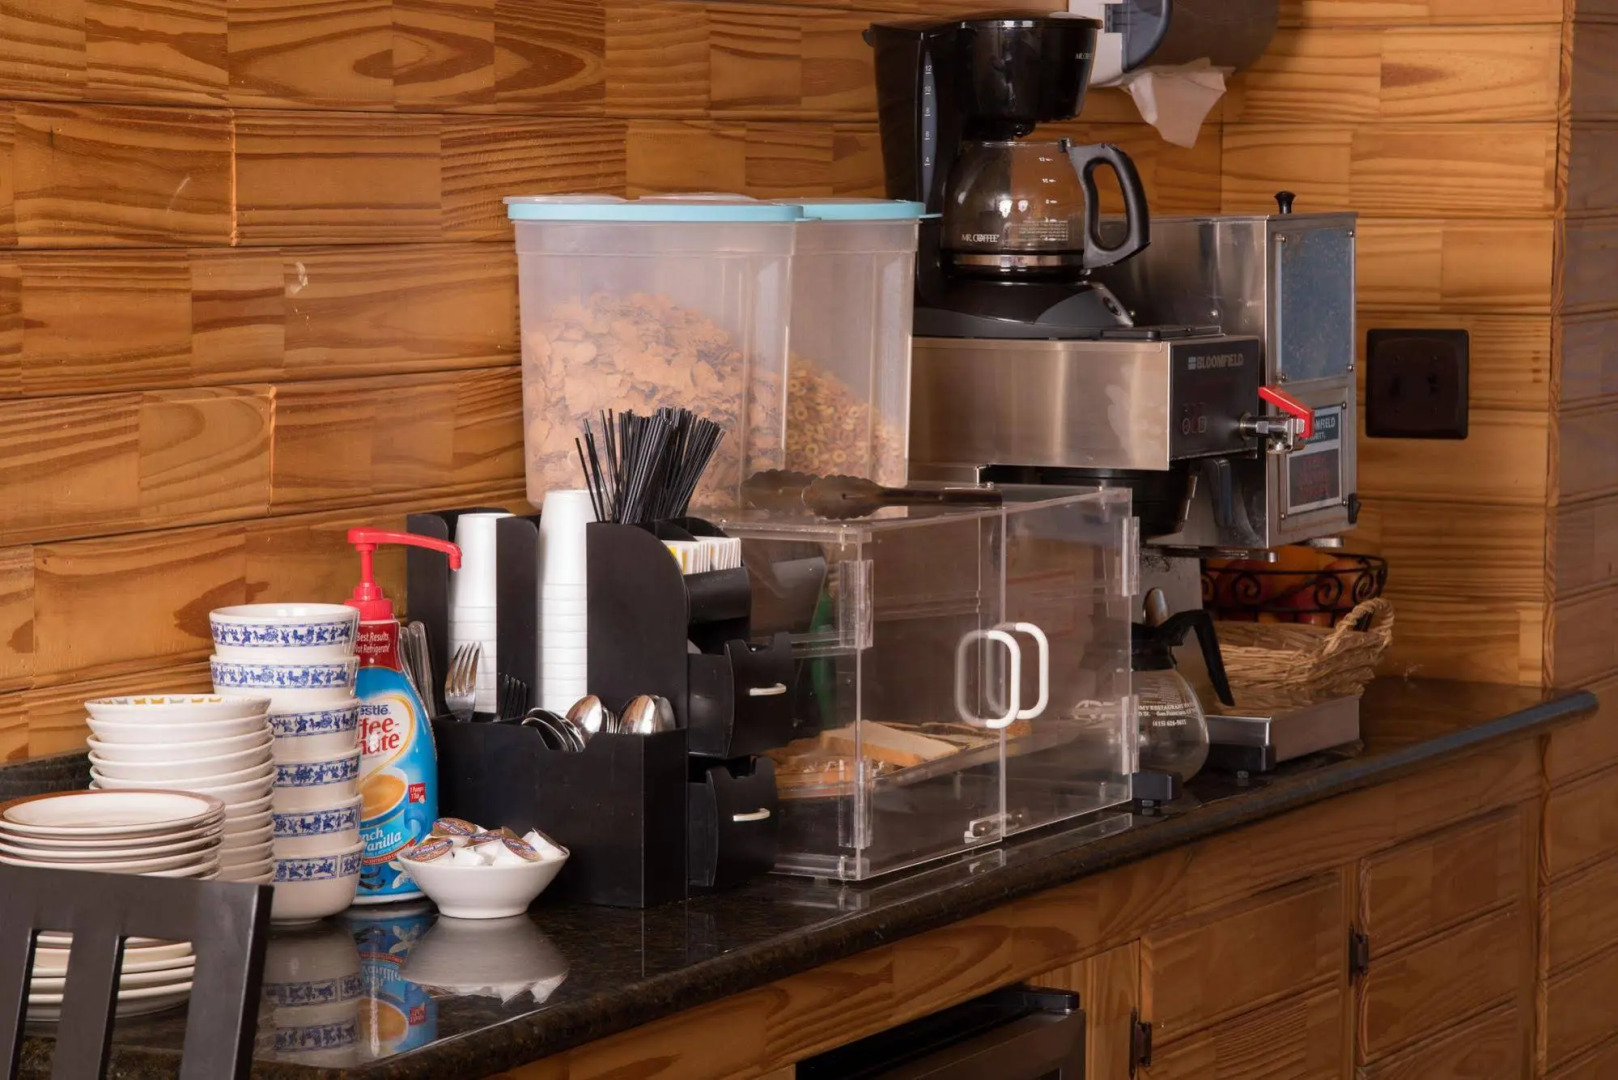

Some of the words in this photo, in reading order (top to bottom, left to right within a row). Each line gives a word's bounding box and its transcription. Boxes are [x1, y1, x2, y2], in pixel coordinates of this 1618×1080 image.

[972, 233, 998, 243] COFFEE
[1196, 353, 1244, 370] BLOOMFIELD
[361, 827, 384, 841] nch
